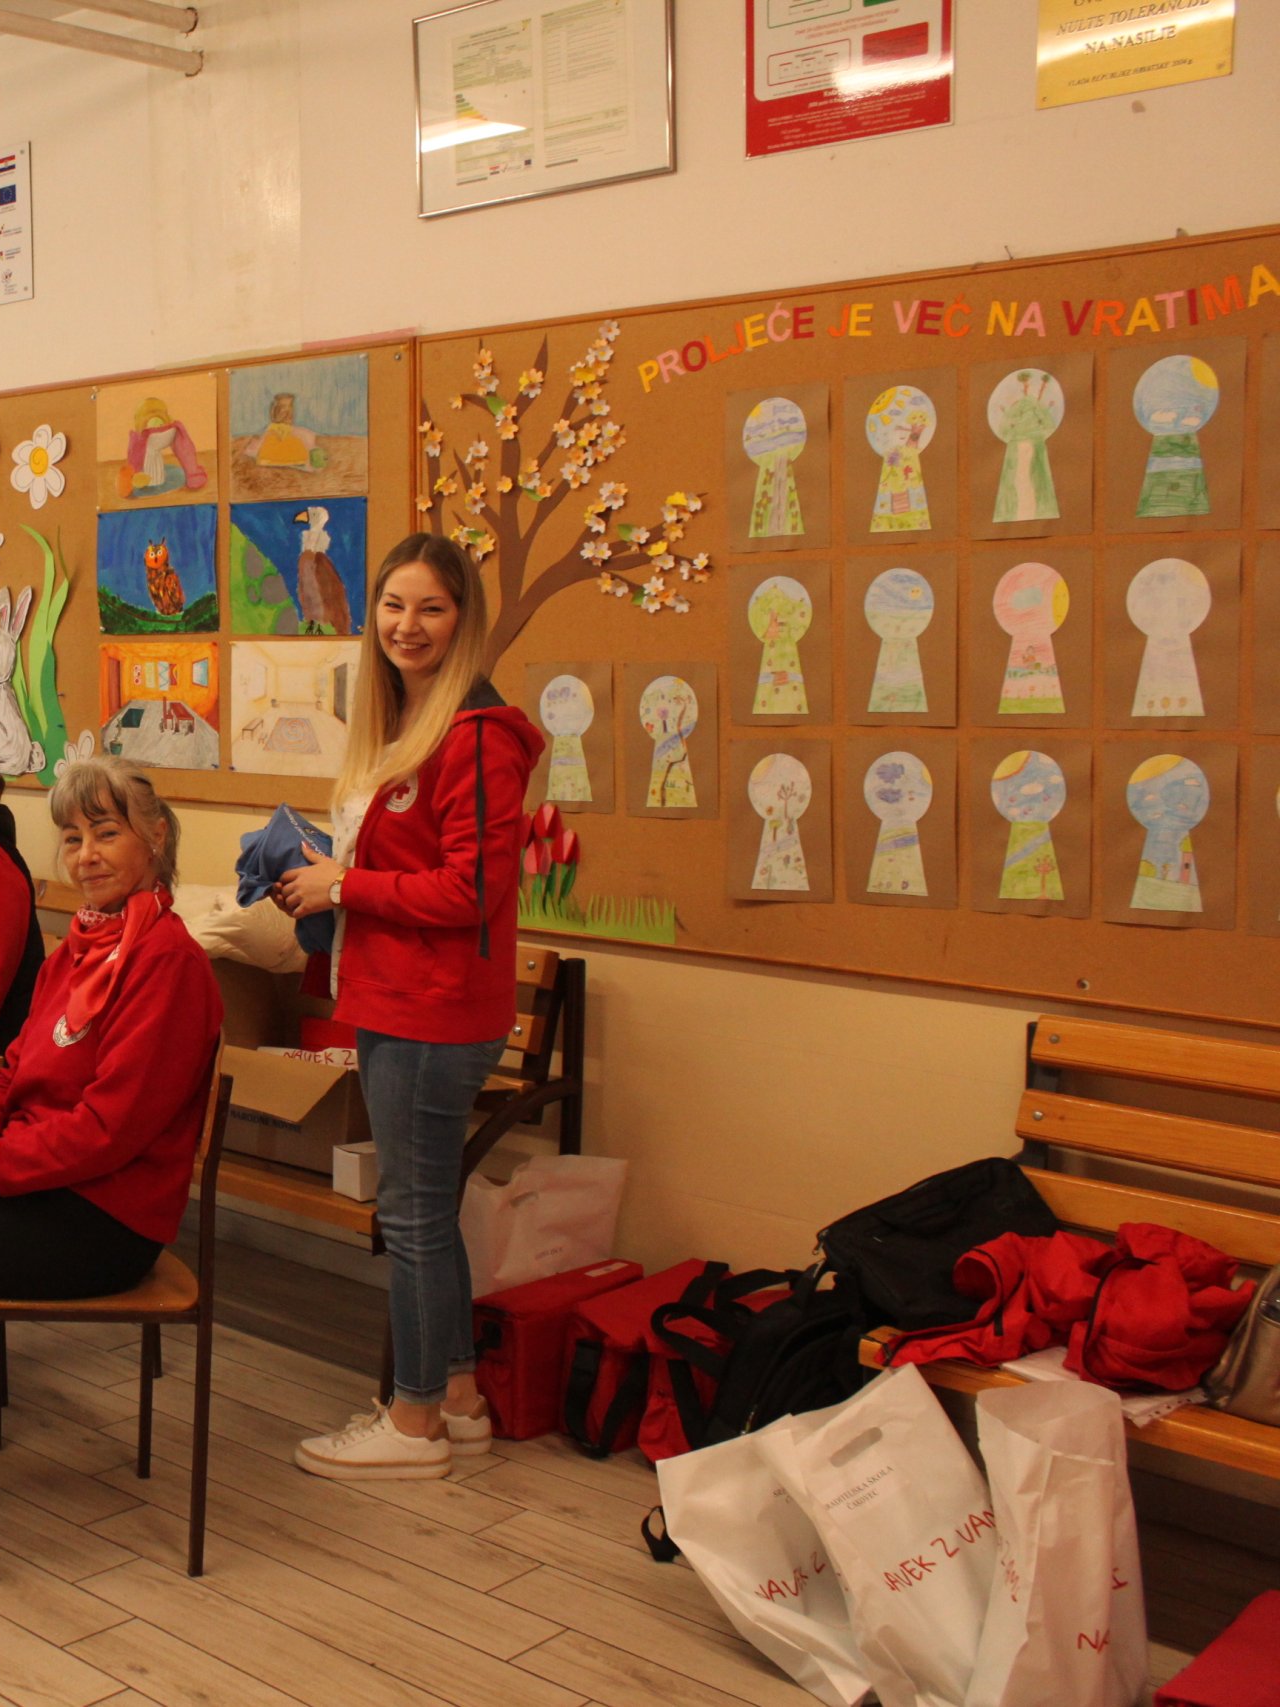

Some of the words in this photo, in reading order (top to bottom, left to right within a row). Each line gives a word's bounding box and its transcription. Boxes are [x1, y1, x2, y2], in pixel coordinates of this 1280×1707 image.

[1056, 14, 1104, 36] NULTE
[1085, 40, 1108, 55] NA
[1112, 25, 1177, 51] NASILJE
[637, 301, 815, 393] PROLJEĆE
[827, 303, 874, 337] JE
[893, 293, 972, 337] VEĆ
[986, 301, 1046, 337] NA
[1061, 263, 1280, 337] VRATIMA
